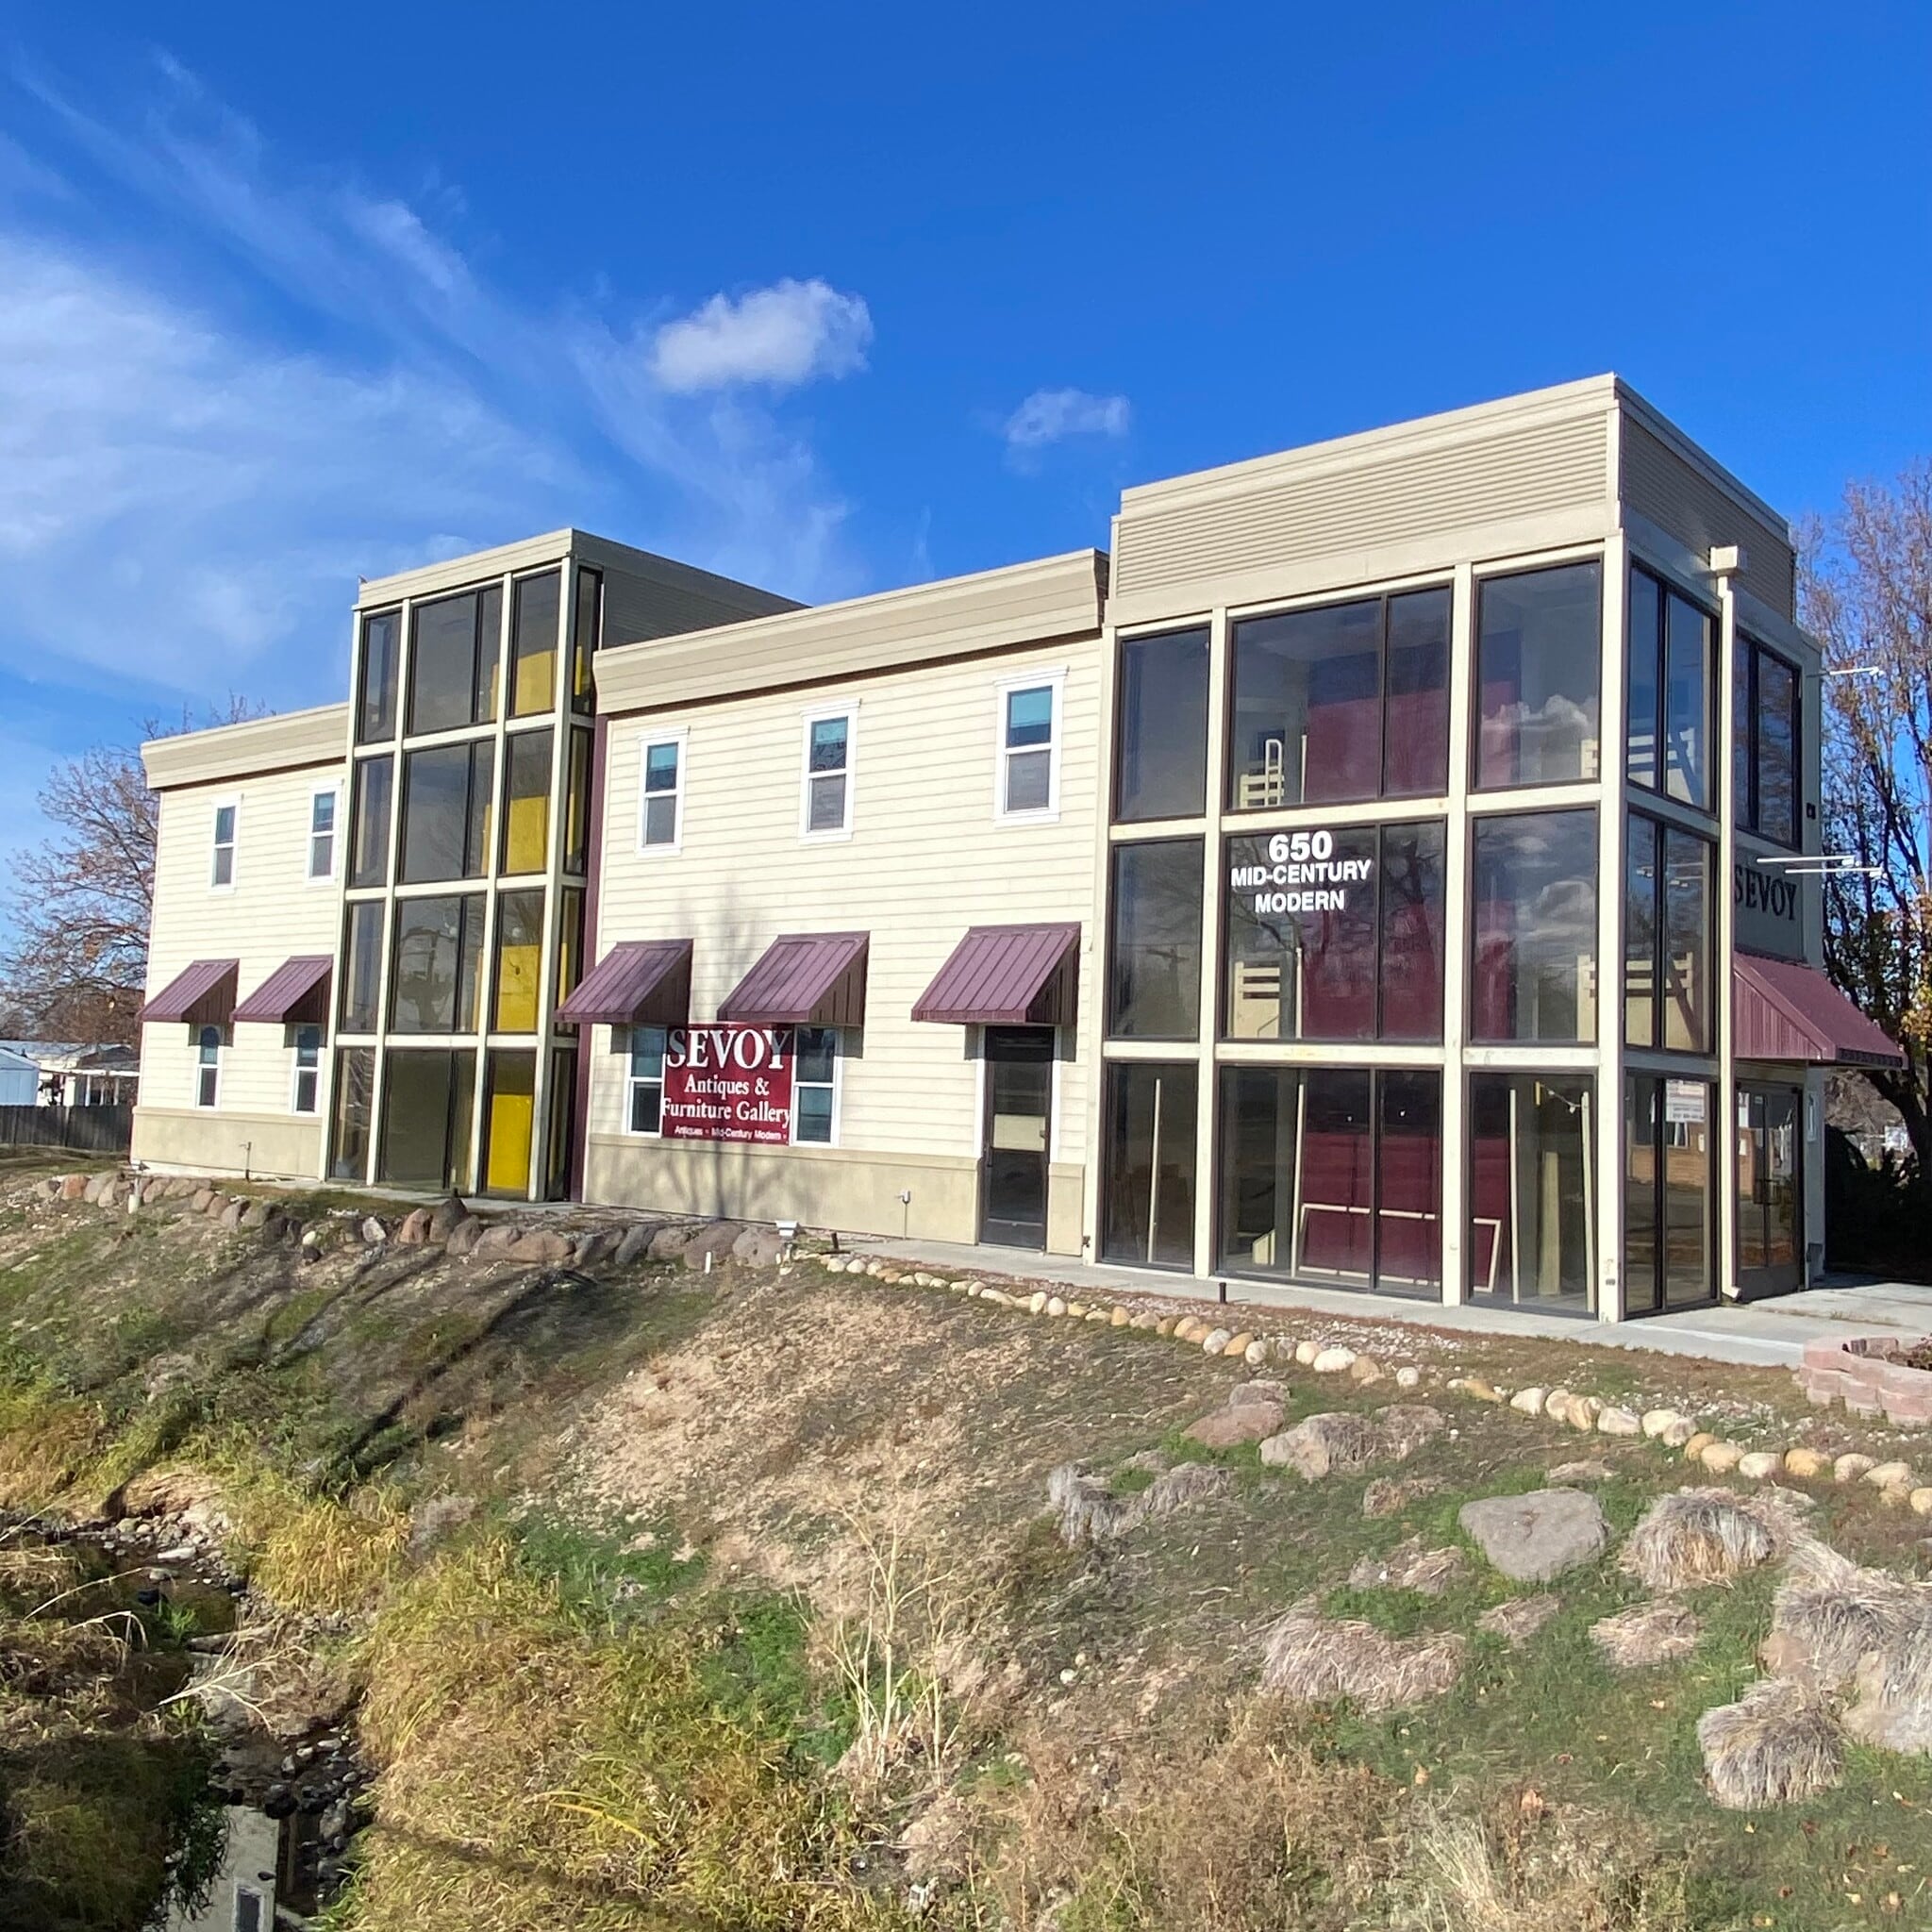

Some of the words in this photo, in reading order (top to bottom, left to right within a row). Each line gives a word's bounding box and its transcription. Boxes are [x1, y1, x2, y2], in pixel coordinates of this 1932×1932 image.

[1268, 830, 1333, 862] 650
[1231, 859, 1372, 887] MID-CENTURY
[1255, 890, 1345, 914] MODERN
[667, 1028, 792, 1069] SEVOY
[684, 1074, 750, 1100] Antiques
[754, 1076, 770, 1095] &
[662, 1097, 732, 1119] Furniture
[736, 1101, 791, 1129] Gallery
